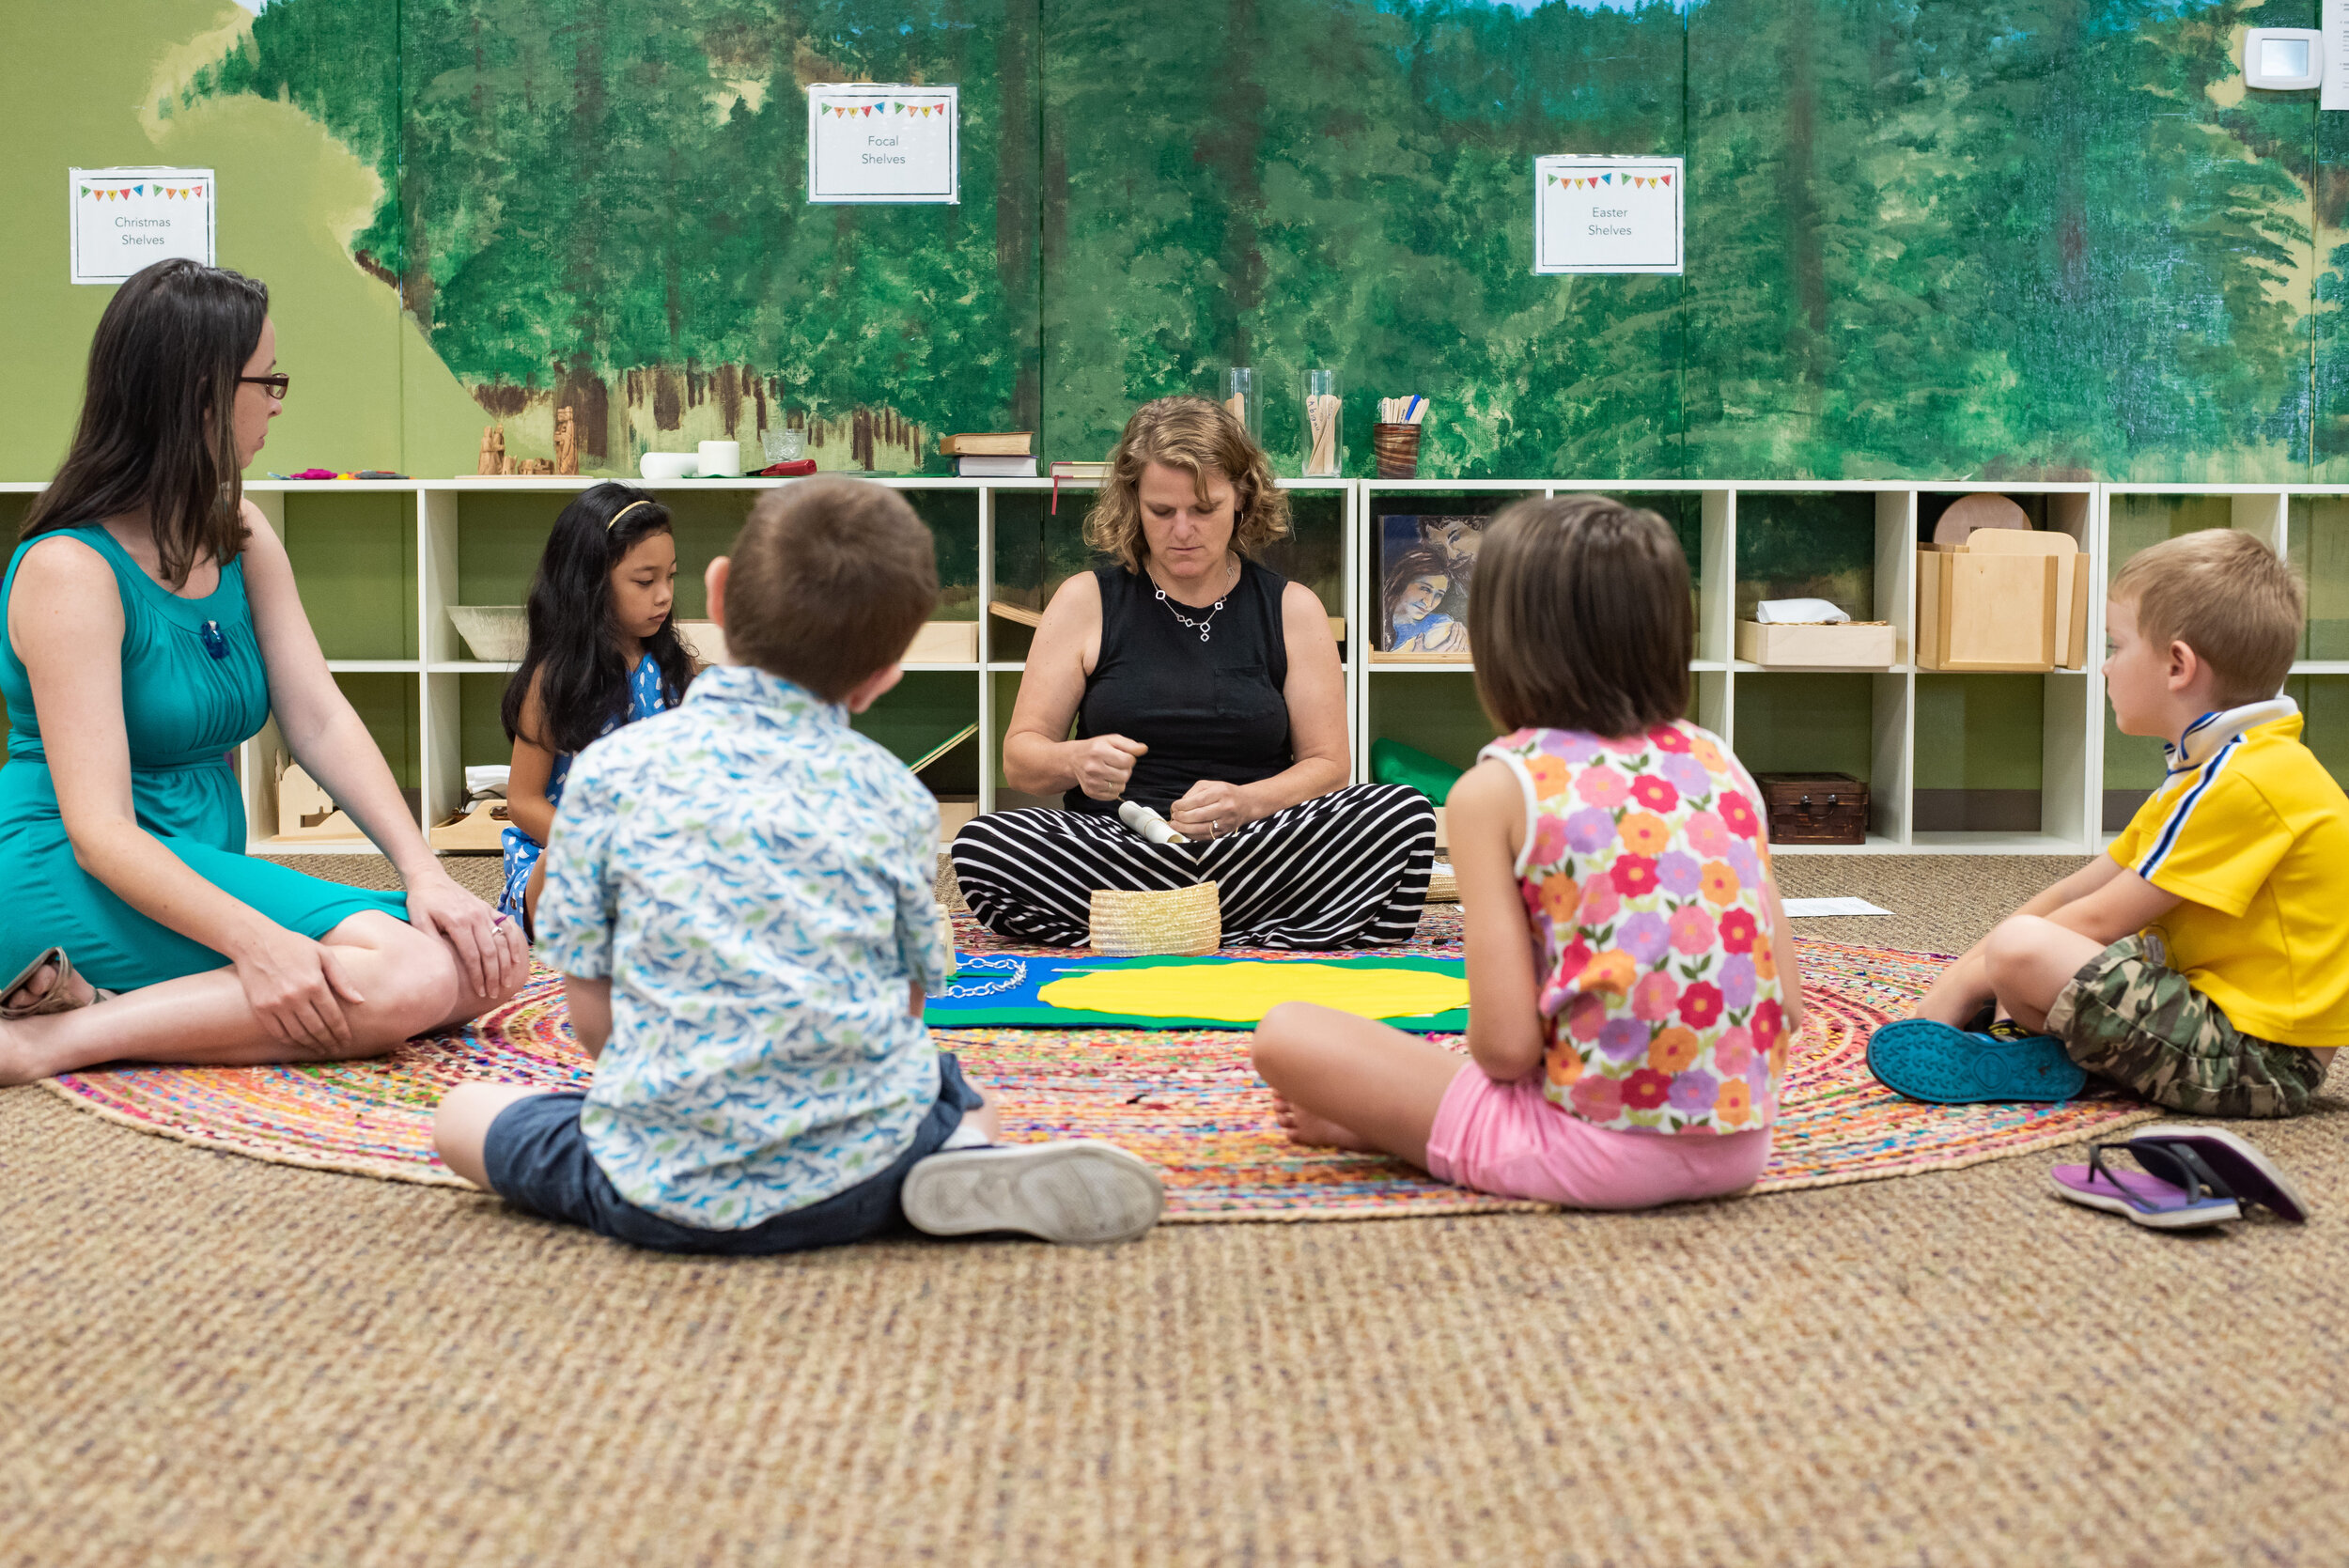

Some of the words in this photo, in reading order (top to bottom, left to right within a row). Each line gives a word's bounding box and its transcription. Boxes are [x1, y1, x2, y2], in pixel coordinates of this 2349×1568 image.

[867, 134, 899, 147] Focal
[862, 153, 906, 164] Shelves
[1592, 207, 1628, 218] Easter
[115, 216, 171, 227] Christmas
[1588, 225, 1632, 236] Shelves
[121, 234, 165, 245] Shelves
